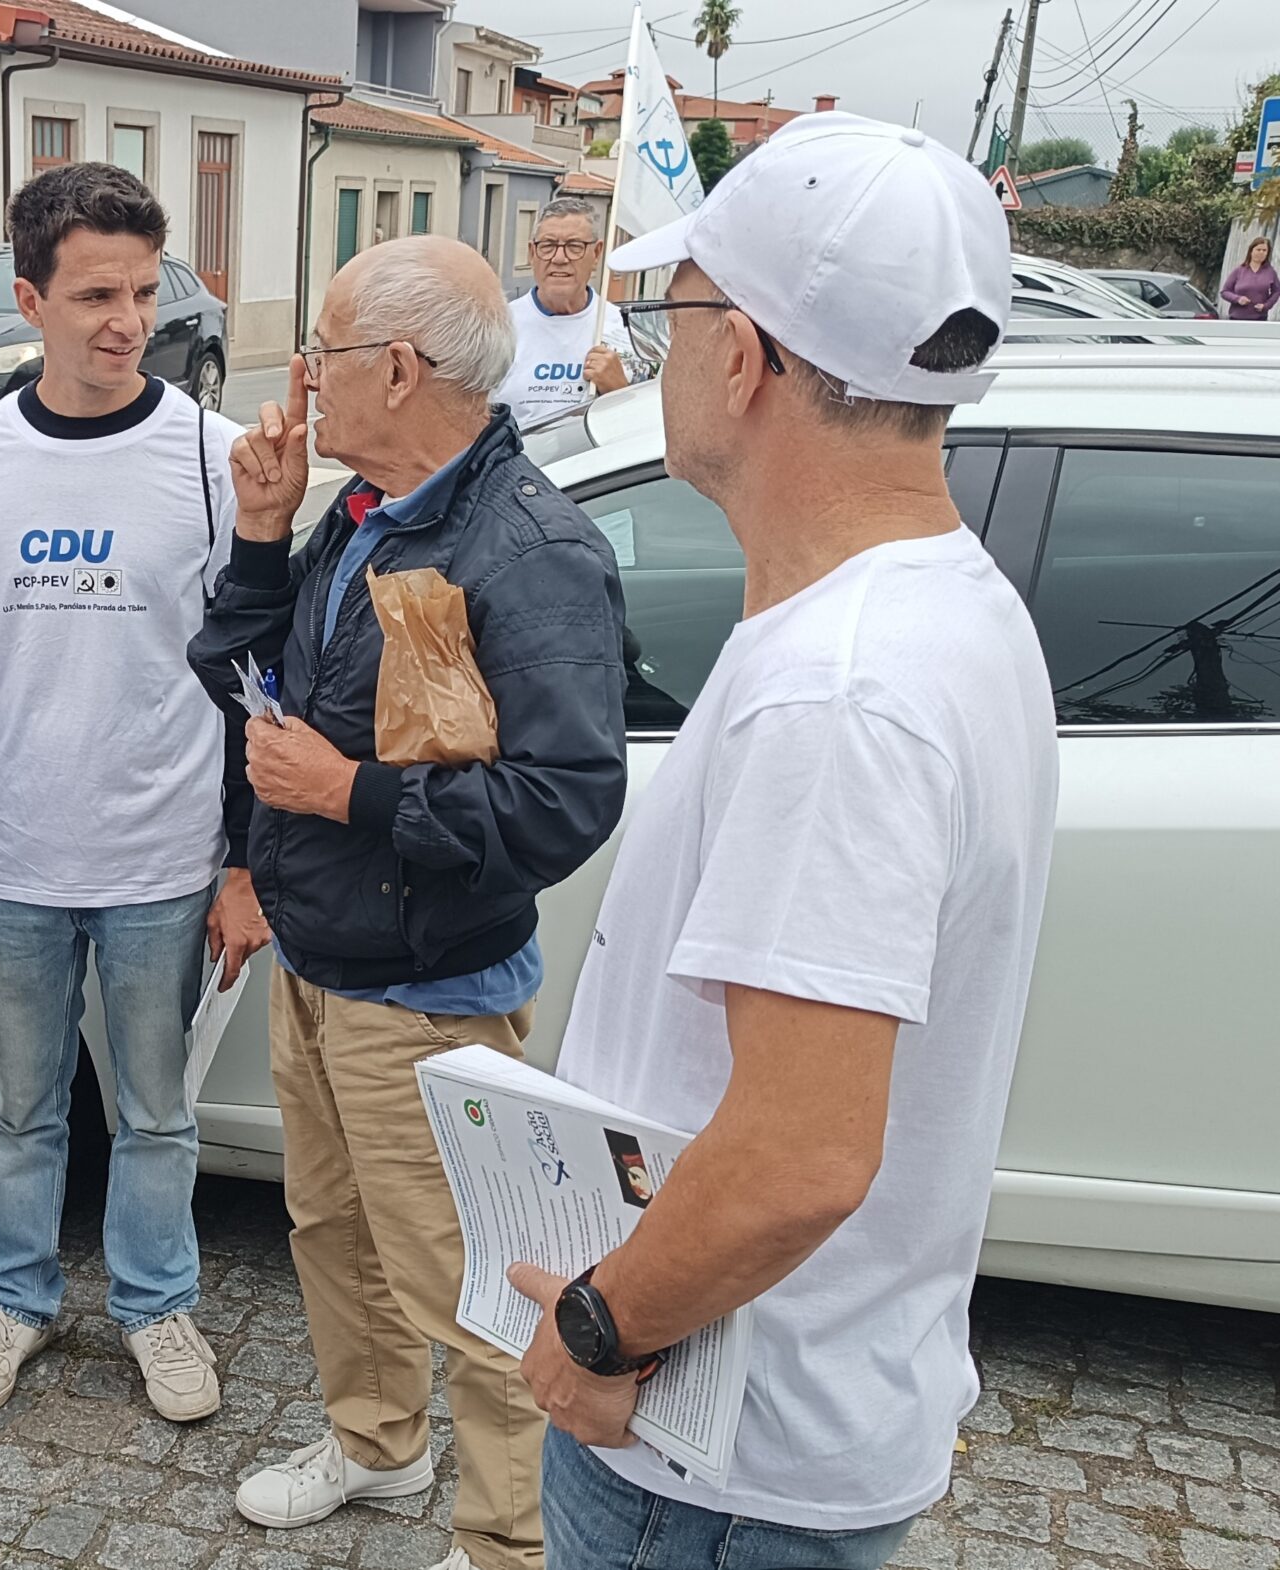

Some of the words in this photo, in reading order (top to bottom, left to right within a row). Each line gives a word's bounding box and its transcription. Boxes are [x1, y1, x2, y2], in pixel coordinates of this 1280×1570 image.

[534, 363, 582, 381] CDU
[528, 384, 560, 393] PCP-PEV
[20, 529, 114, 565] CDU
[14, 575, 69, 588] PCP-PEV
[59, 602, 86, 611] Panóias
[93, 603, 116, 612] Parada
[117, 604, 126, 612] de
[526, 1110, 548, 1149] Ação
[533, 1110, 560, 1156] Social
